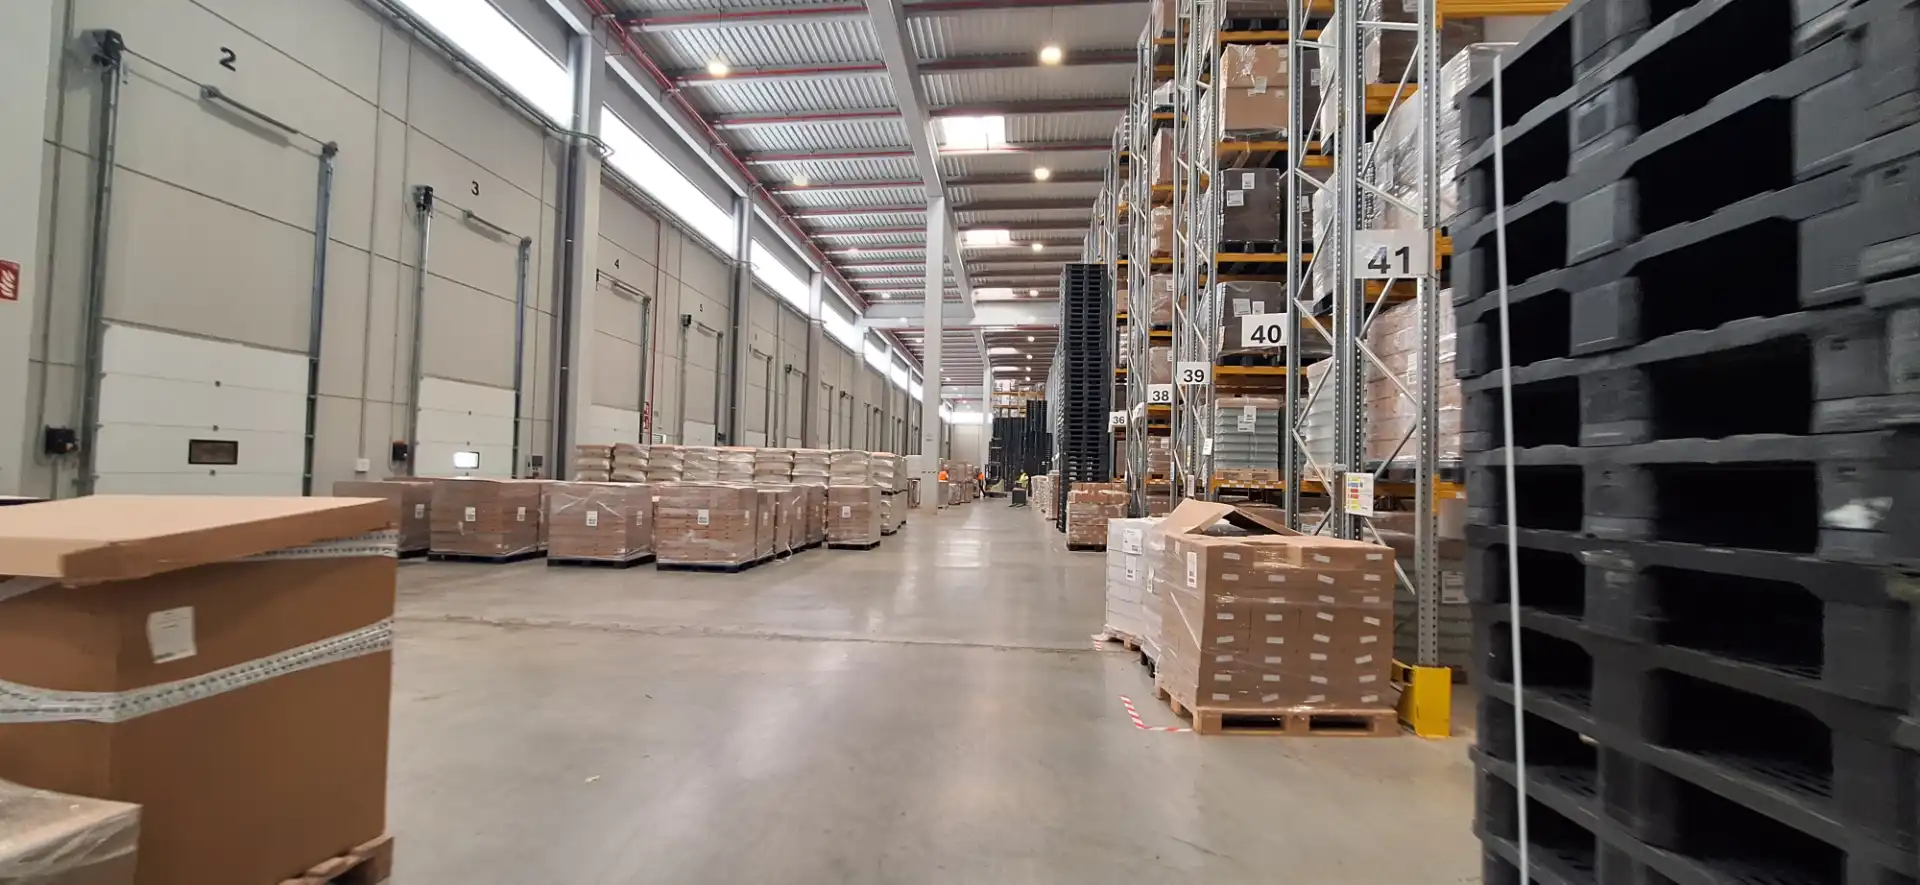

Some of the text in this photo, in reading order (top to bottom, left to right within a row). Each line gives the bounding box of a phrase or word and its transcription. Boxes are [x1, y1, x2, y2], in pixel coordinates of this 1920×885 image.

[219, 46, 236, 72] 2
[471, 180, 480, 196] 3
[614, 258, 620, 270] 4
[1368, 246, 1409, 274] 41
[1250, 324, 1282, 344] 40
[1183, 369, 1205, 382] 39
[1152, 390, 1169, 401] 38
